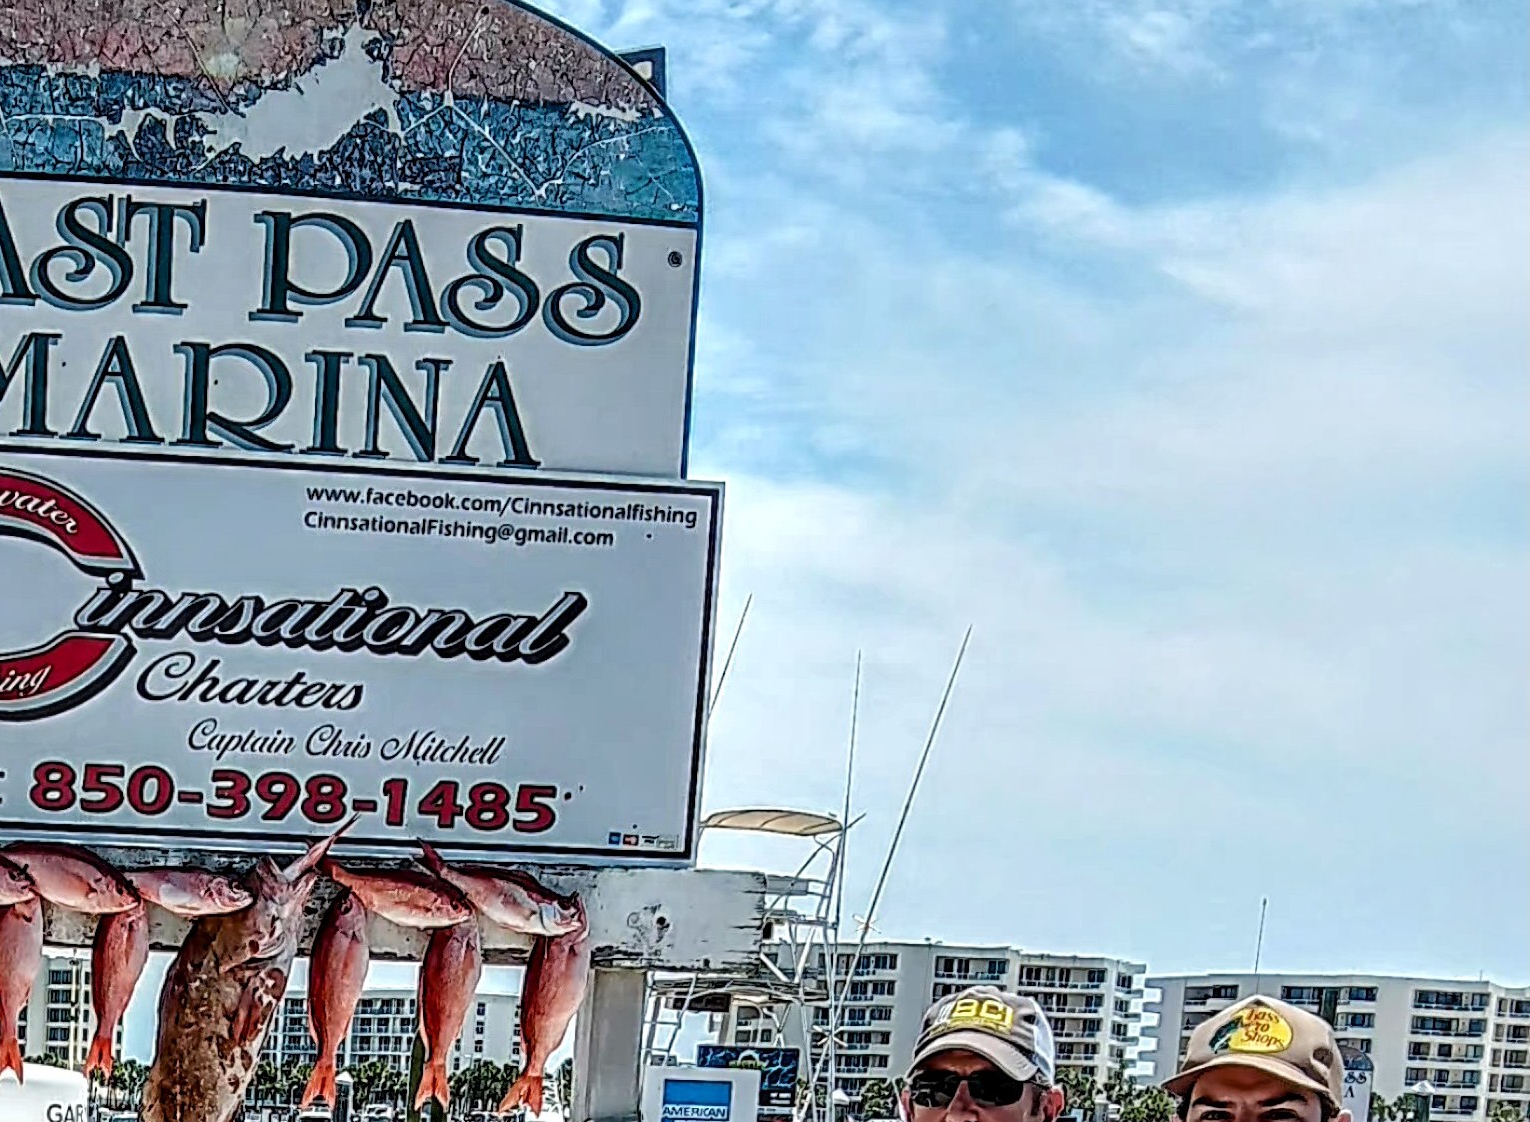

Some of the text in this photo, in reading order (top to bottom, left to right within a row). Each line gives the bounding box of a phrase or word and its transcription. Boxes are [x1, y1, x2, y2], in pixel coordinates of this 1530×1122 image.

[250, 210, 642, 346] PASS
[303, 511, 615, 547] CinnsationalFishing@gmail.com
[306, 484, 698, 529] www.facebook.com/Cinnsationalfishing
[136, 651, 365, 711] Charters
[187, 717, 506, 765] Captain Chris Mitchell
[28, 761, 559, 832] 850-398-1485
[1343, 1072, 1367, 1084] SS
[662, 1106, 727, 1119] AMERICAN
